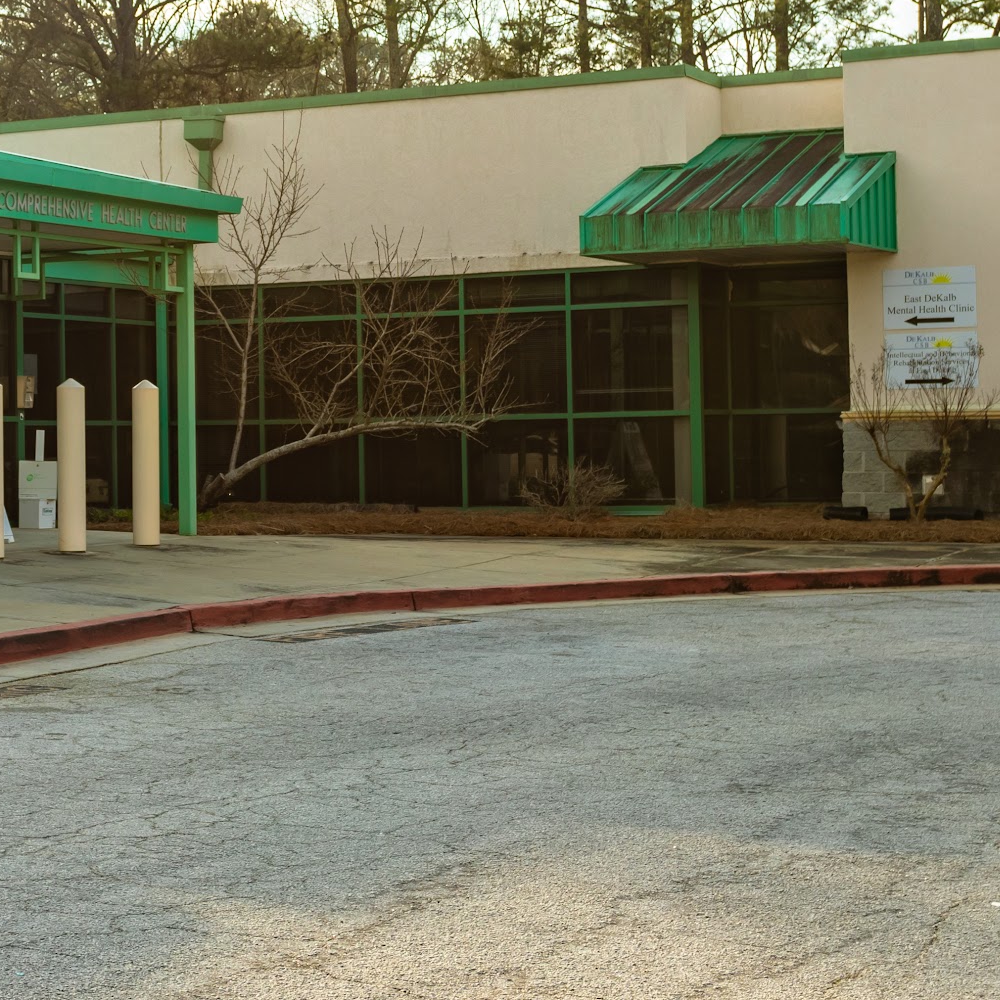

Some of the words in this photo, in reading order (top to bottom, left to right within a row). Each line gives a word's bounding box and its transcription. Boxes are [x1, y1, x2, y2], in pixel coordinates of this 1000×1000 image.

[100, 202, 142, 227] HEALTH
[148, 210, 187, 233] CENTER
[904, 295, 922, 303] East
[924, 293, 957, 303] DeKalb
[887, 306, 916, 315] Mental
[918, 304, 946, 314] Health
[948, 303, 974, 313] Clinic
